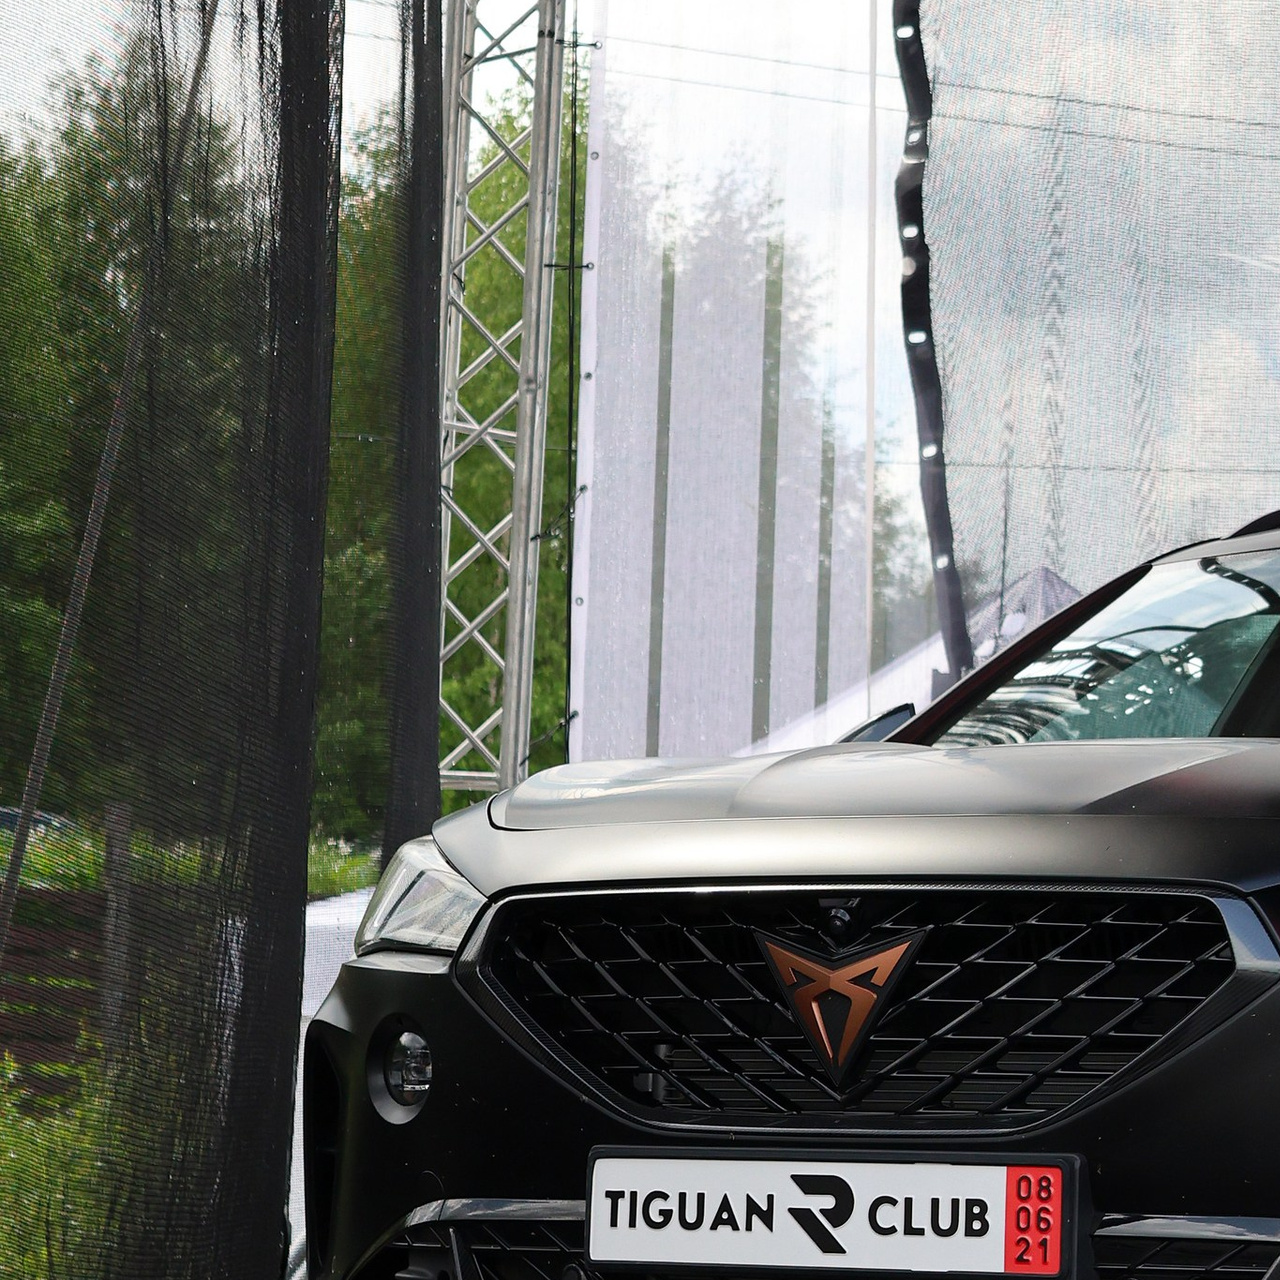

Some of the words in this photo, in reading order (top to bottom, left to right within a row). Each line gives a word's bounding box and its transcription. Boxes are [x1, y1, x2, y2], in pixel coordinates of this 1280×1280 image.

[1016, 1175, 1052, 1204] 08
[604, 1190, 775, 1233] TIGUAN
[867, 1195, 990, 1238] CLUB
[1015, 1206, 1052, 1235] 06
[1014, 1237, 1050, 1266] 21
